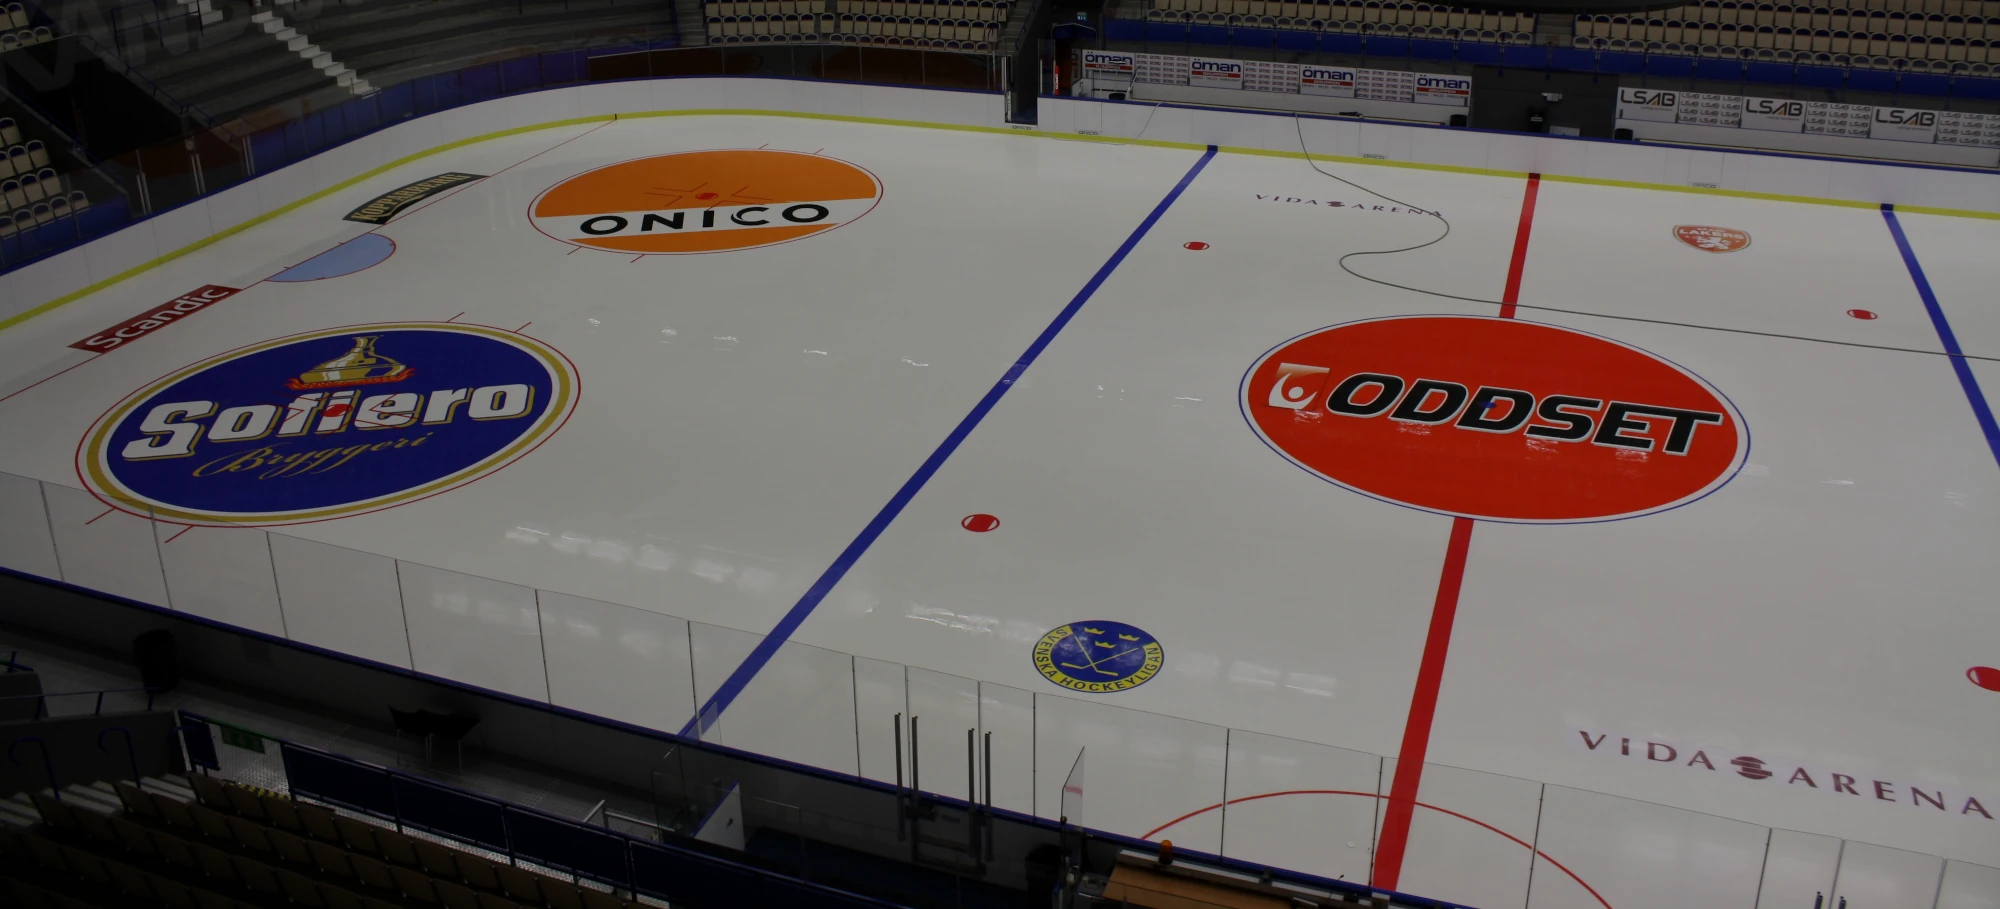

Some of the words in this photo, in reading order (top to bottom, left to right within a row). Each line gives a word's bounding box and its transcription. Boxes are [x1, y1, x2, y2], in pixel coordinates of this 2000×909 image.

[1085, 51, 1133, 65] öman
[1192, 58, 1241, 73] öman
[1303, 66, 1353, 81] öman
[1417, 74, 1469, 89] öman
[1620, 89, 1676, 107] LSAB
[1745, 99, 1803, 117] LSAB
[1875, 108, 1935, 127] LSAB
[1256, 194, 1319, 205] VIDA
[1351, 203, 1443, 217] ARENA
[580, 203, 829, 236] ONICO
[1679, 228, 1745, 239] LAKERS
[86, 289, 230, 349] Scandic
[120, 382, 535, 462] Sofiero
[1325, 371, 1724, 457] ODDSET
[192, 431, 434, 481] Bryggeri
[1036, 628, 1069, 678] SVENSKA
[1060, 647, 1161, 692] HOCKEYLIGAN
[1578, 730, 1717, 771] VIDA
[1788, 766, 1996, 820] ARENA
